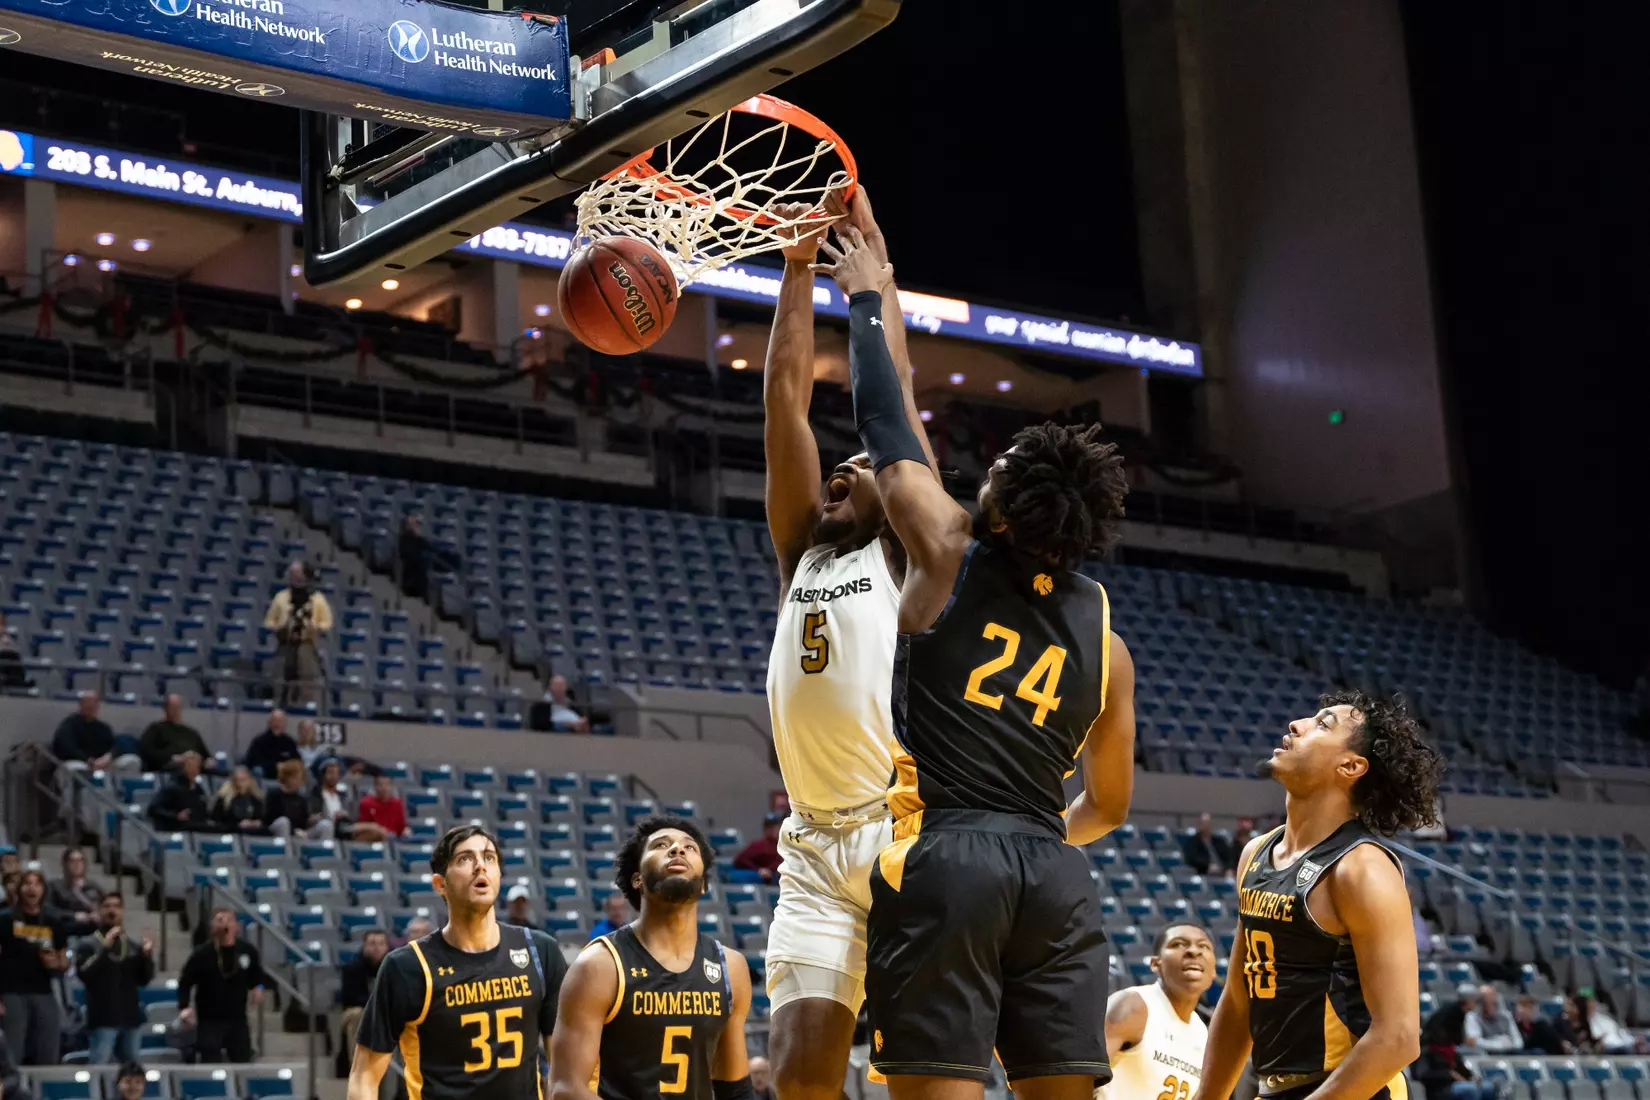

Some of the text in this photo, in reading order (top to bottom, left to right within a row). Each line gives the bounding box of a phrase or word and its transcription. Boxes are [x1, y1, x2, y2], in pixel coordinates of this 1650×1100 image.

[196, 3, 325, 44] Health Network
[432, 28, 516, 56] Lutheran
[101, 51, 242, 84] Health Network
[133, 65, 230, 89] Lutheran
[434, 50, 556, 81] Health Network
[94, 155, 118, 180] S.
[121, 159, 180, 191] Main
[183, 171, 213, 197] St.
[608, 260, 656, 336] Wilson
[640, 254, 674, 304] NCAA
[800, 609, 829, 674] 5
[963, 622, 1067, 727] 24
[1239, 887, 1295, 922] OMMERCE
[445, 974, 532, 1007] COMMERCE
[632, 990, 722, 1016] COMMERCE
[460, 1006, 524, 1073] 35
[659, 1025, 693, 1094] 5
[1153, 1050, 1203, 1079] MASTODON
